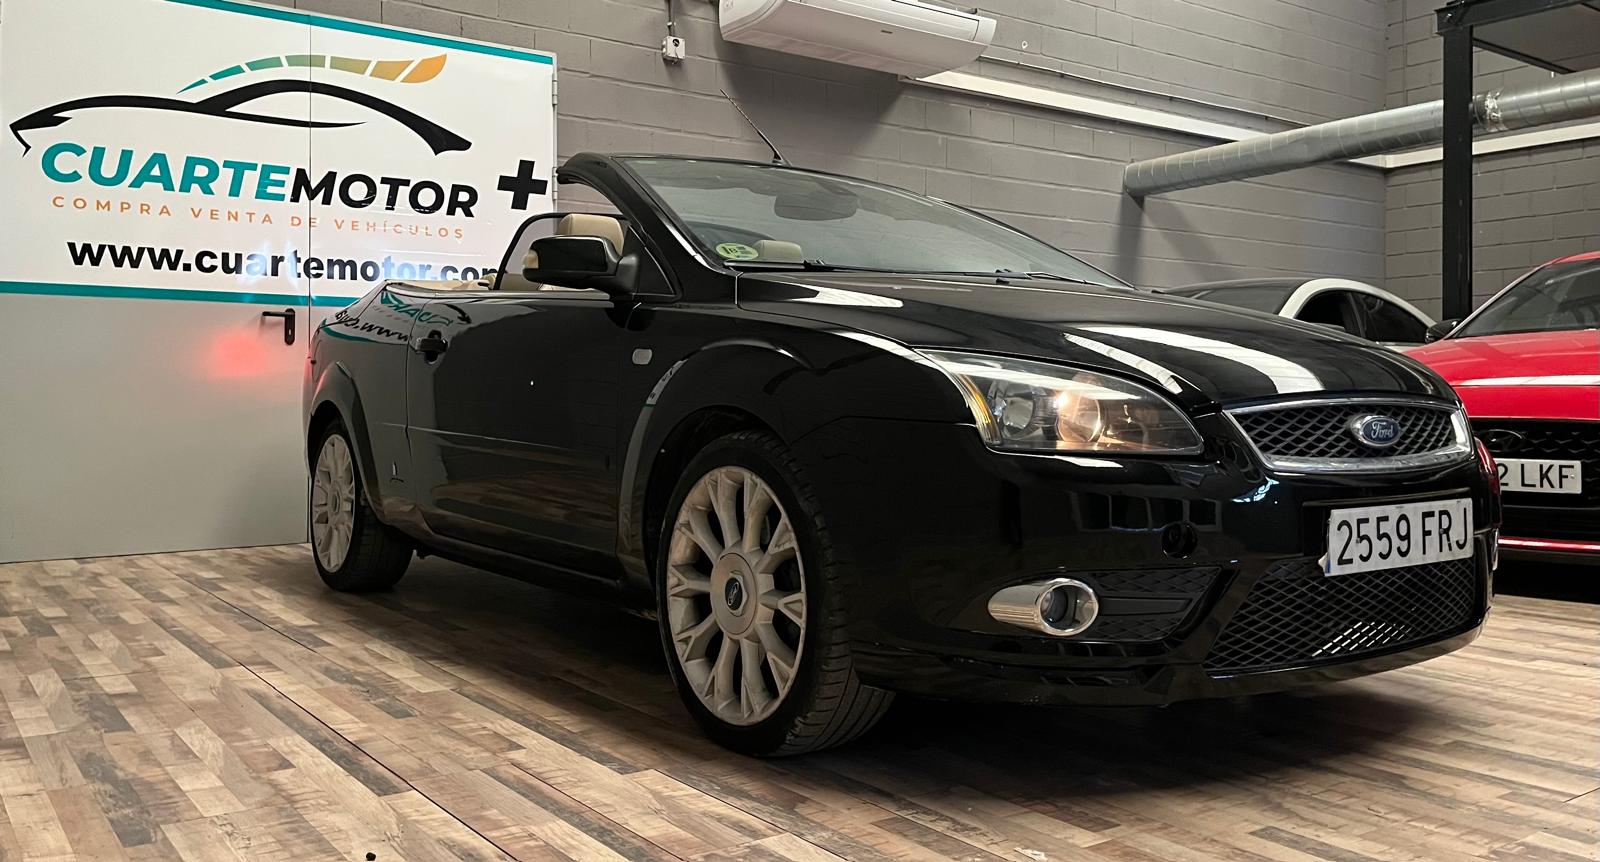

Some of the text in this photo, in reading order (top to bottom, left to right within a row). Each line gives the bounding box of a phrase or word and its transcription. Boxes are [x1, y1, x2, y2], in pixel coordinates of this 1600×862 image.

[41, 142, 479, 218] CUARTEMOTOR
[52, 195, 464, 239] COMPRA VENTA DE VEHÍCULOS
[1371, 421, 1394, 439] Ford
[1520, 463, 1575, 489] LKF
[1336, 507, 1468, 566] 2559 FRJ
